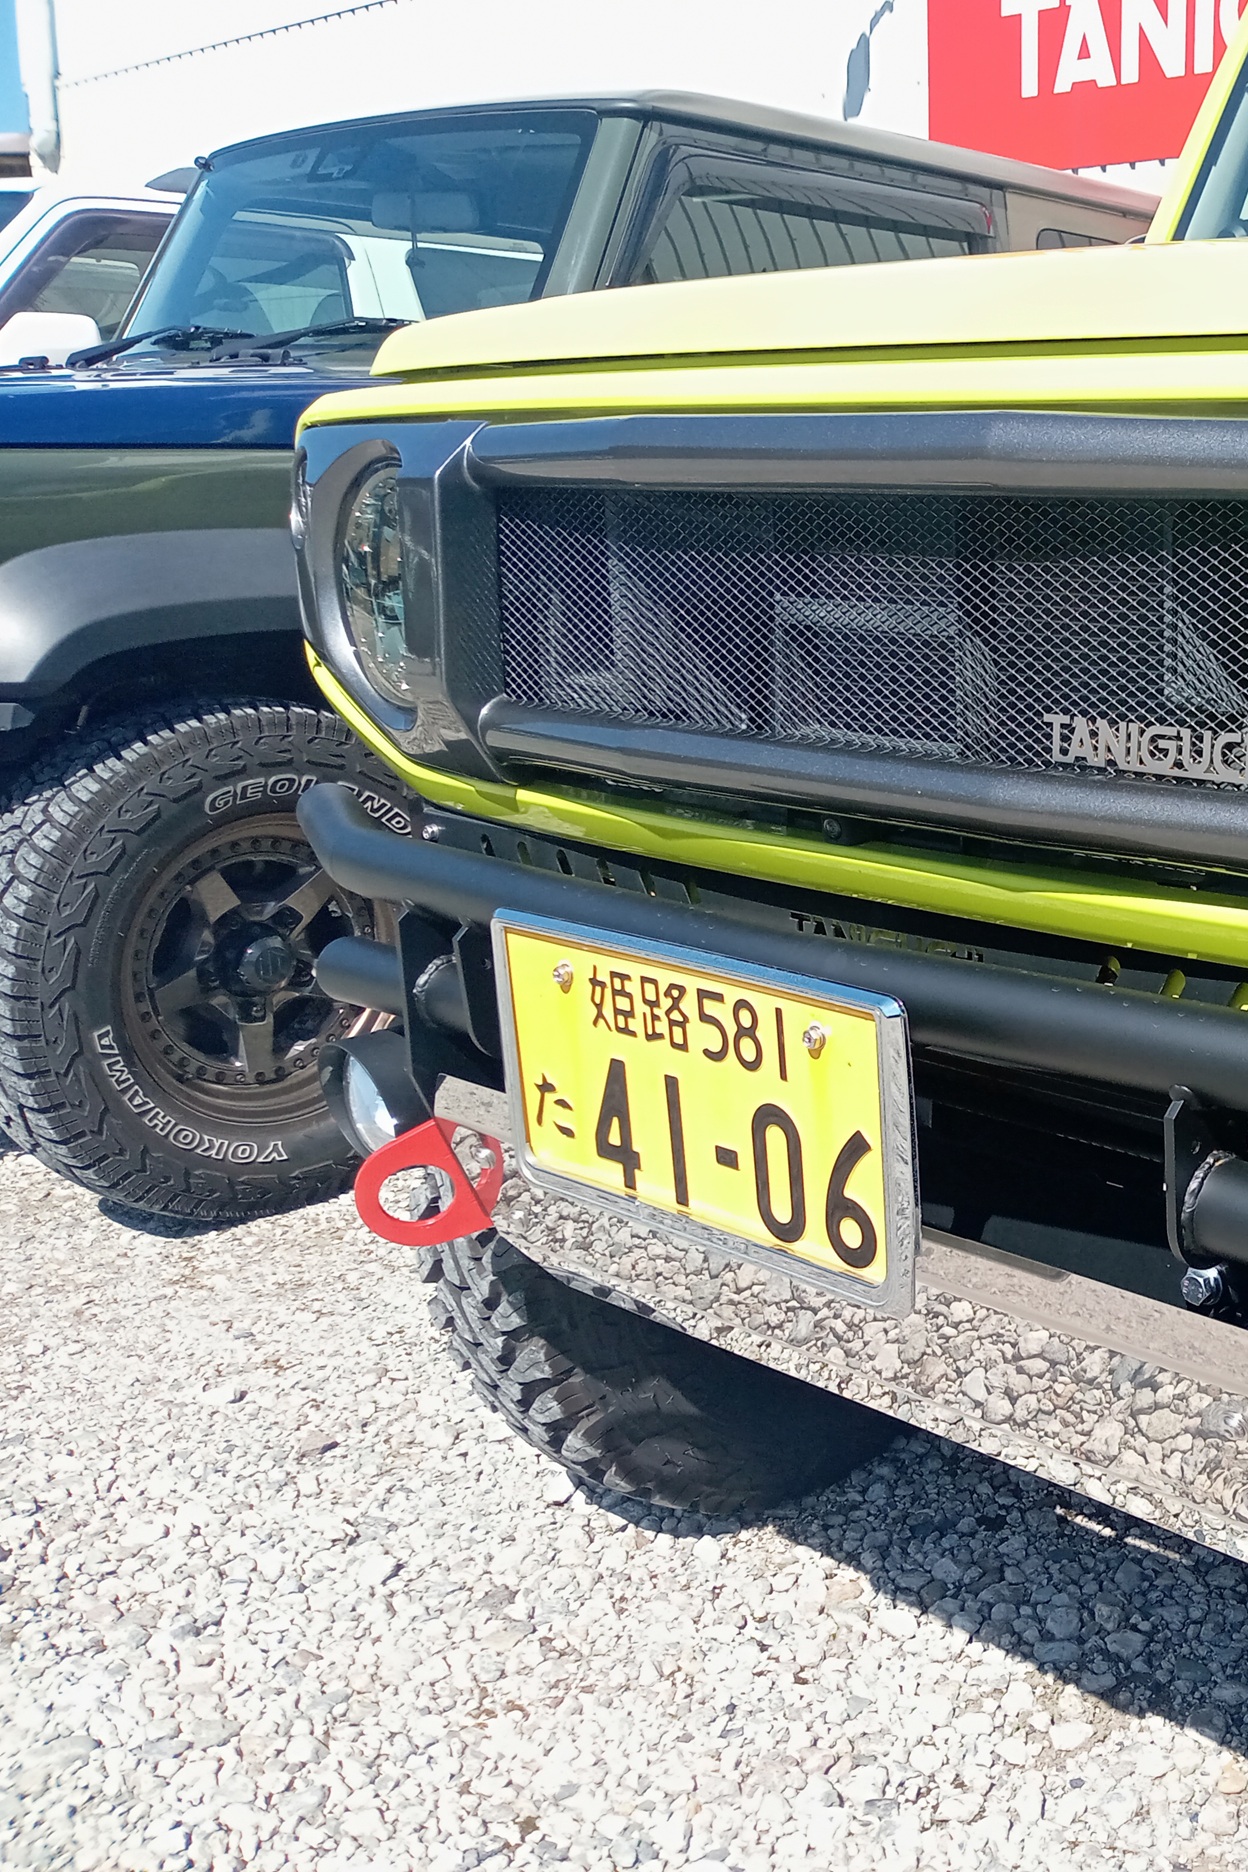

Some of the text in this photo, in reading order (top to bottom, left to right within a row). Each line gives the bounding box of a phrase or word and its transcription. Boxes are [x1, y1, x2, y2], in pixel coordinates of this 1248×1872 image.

[94, 1025, 290, 1164] YOKOHAMA
[533, 1057, 878, 1270] た 41-06
